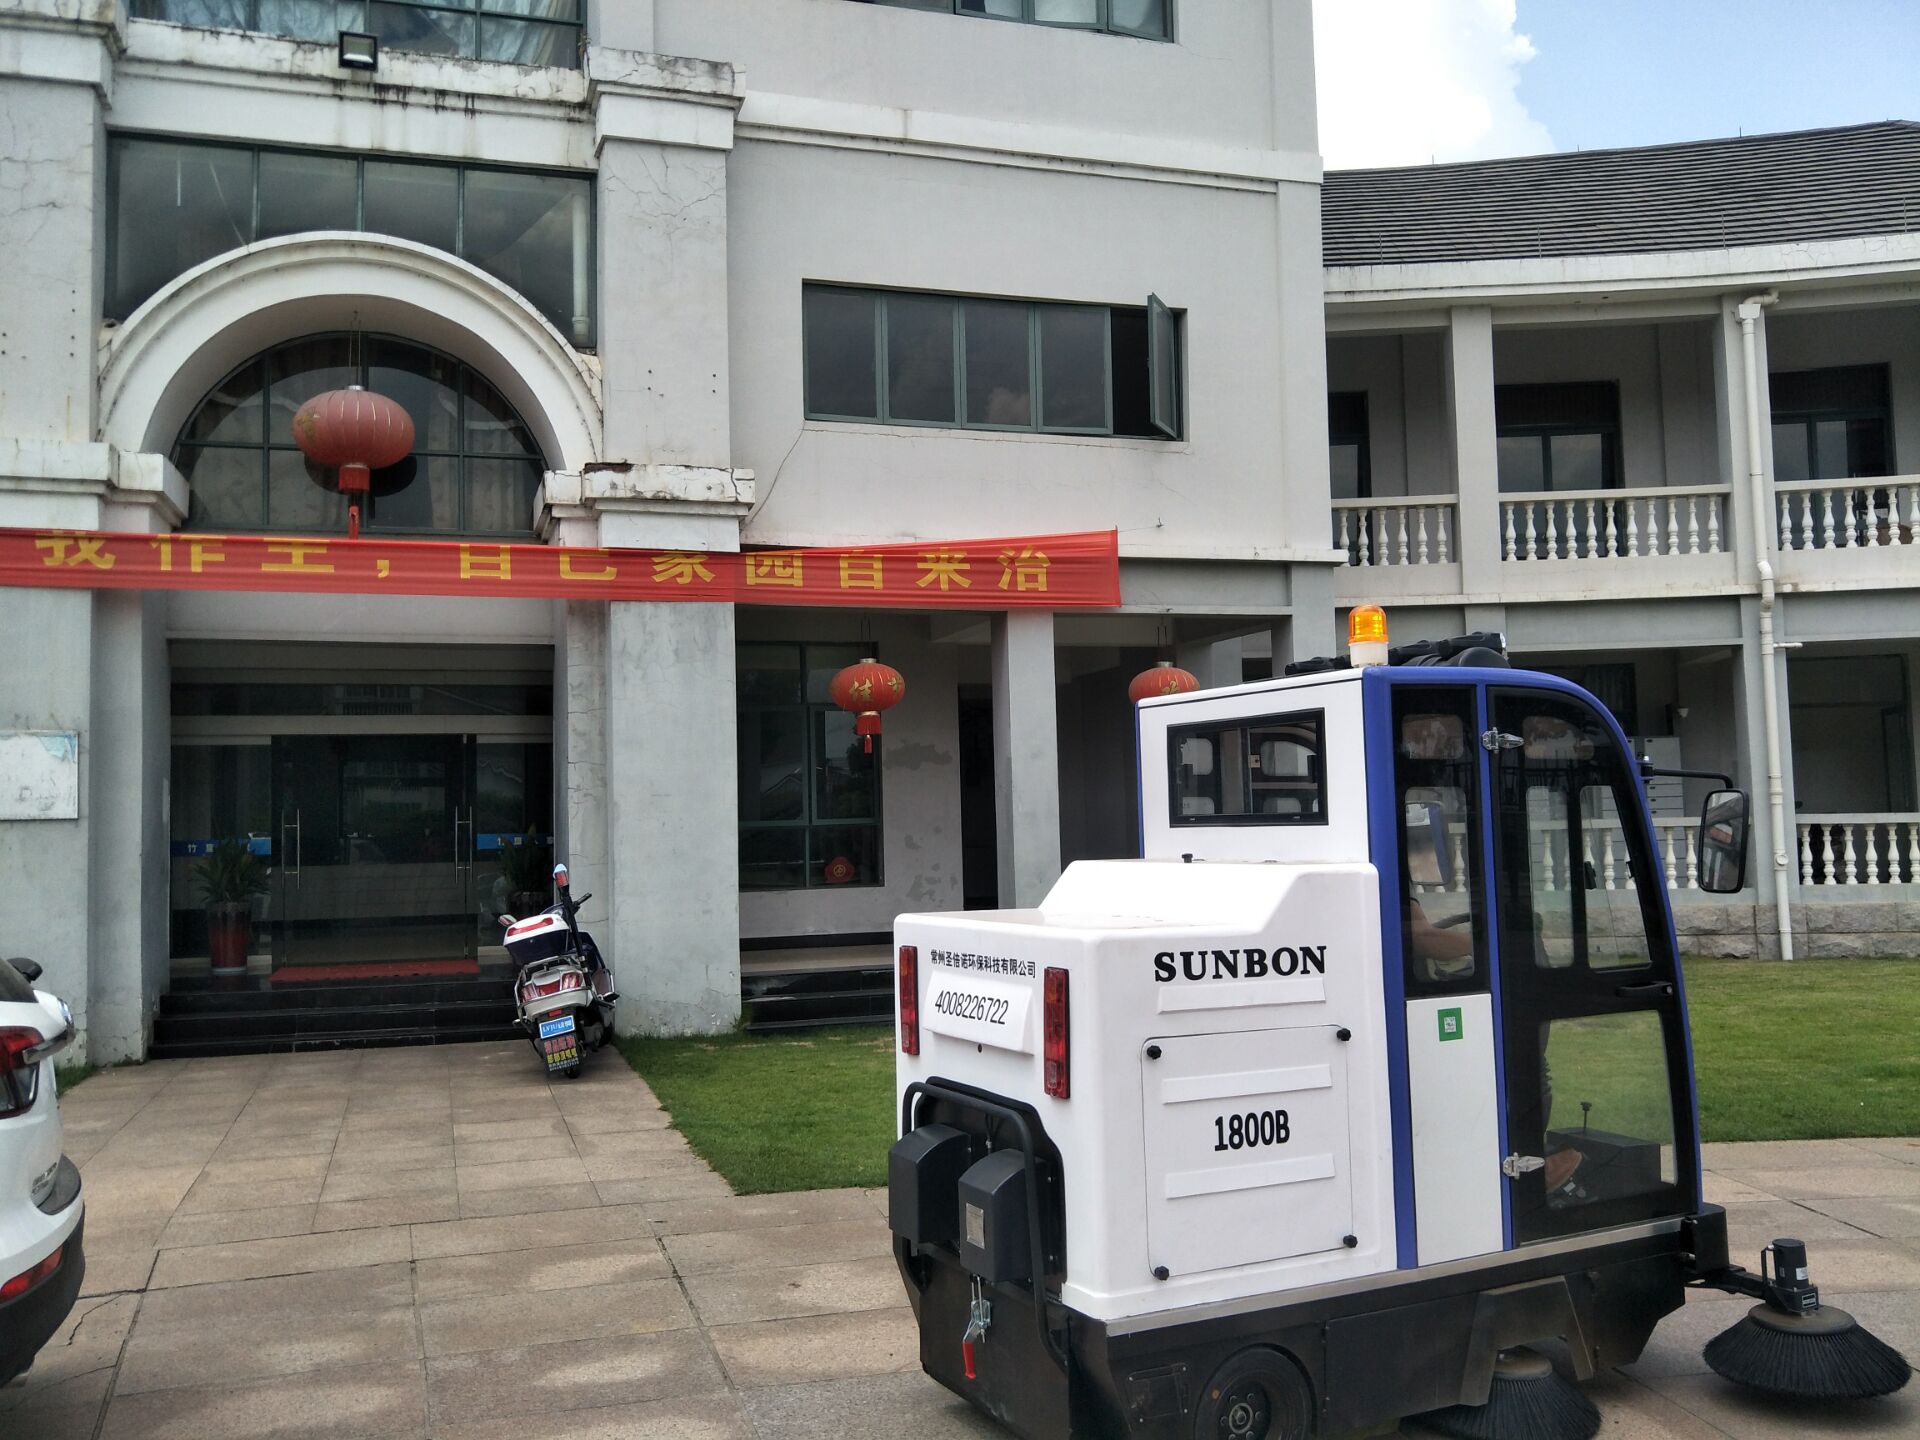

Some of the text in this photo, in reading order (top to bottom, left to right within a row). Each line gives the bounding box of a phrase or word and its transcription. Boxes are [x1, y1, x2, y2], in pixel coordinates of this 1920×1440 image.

[1153, 945, 1327, 982] SUNBON
[935, 989, 1009, 1025] 4008226722
[1214, 1109, 1291, 1152] 1800B
